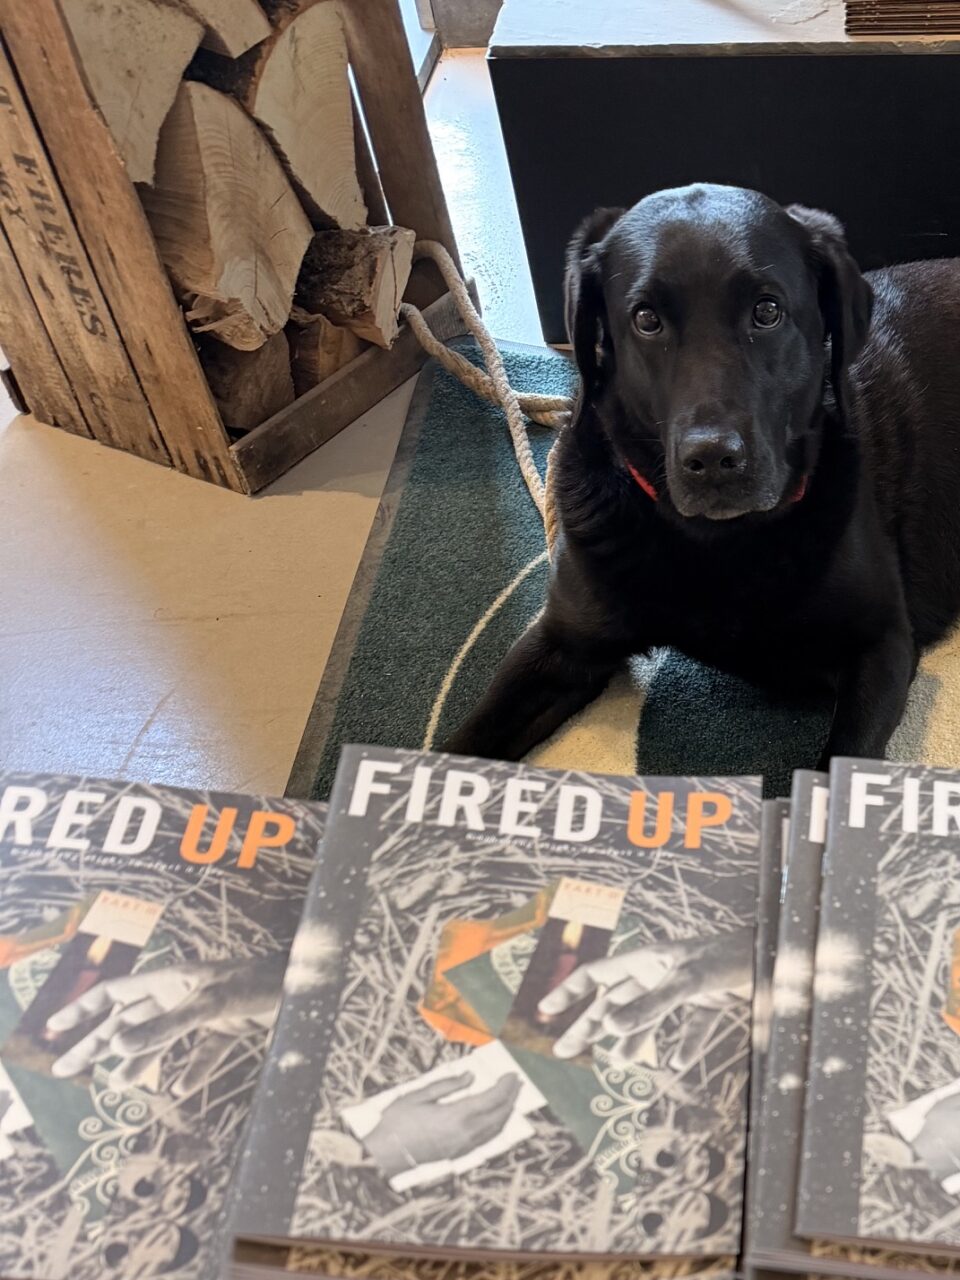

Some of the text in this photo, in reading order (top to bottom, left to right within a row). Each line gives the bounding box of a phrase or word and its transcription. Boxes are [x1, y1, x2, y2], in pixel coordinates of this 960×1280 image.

[14, 152, 107, 338] FRERES
[178, 803, 296, 869] UP
[347, 759, 604, 842] FIRED
[626, 790, 733, 849] UP
